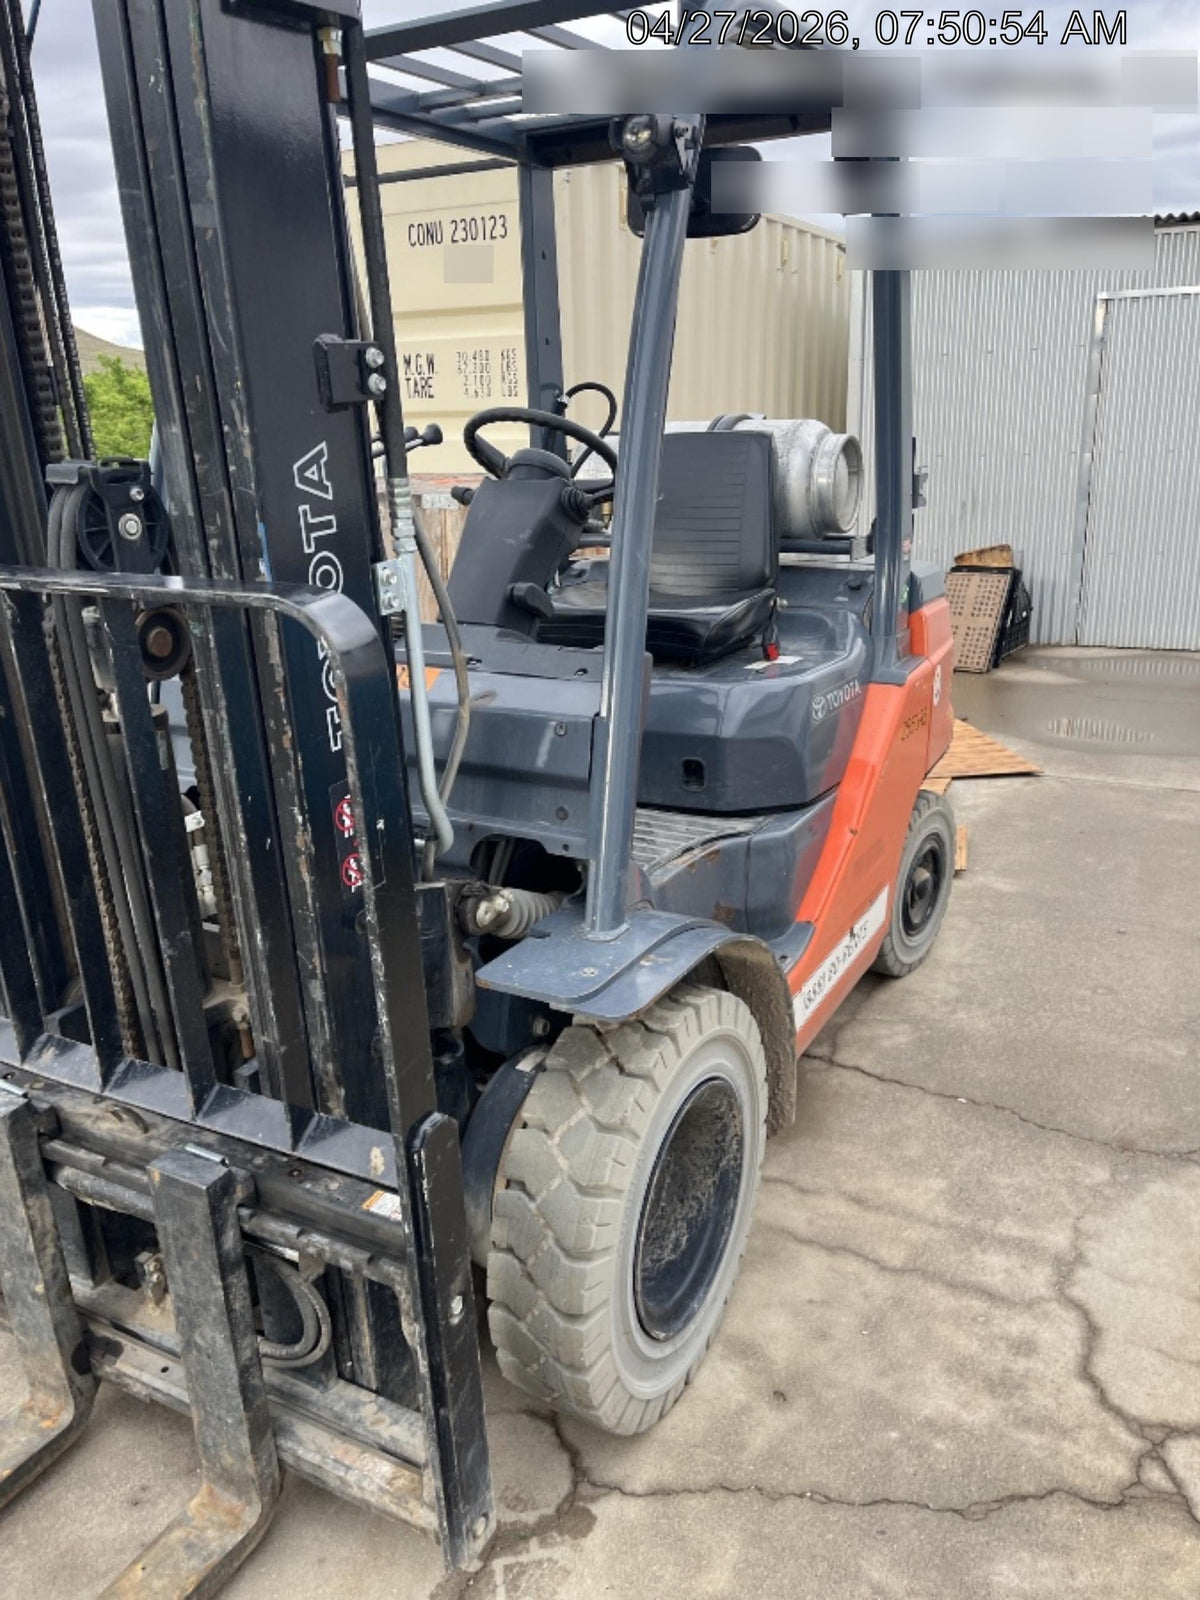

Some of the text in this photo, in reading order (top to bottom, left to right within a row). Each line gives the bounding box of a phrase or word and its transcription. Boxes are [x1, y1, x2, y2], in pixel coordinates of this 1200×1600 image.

[450, 214, 508, 244] 230123
[403, 353, 438, 376] M.G.W.
[406, 377, 435, 398] TARE
[826, 679, 862, 710] TOYOTA
